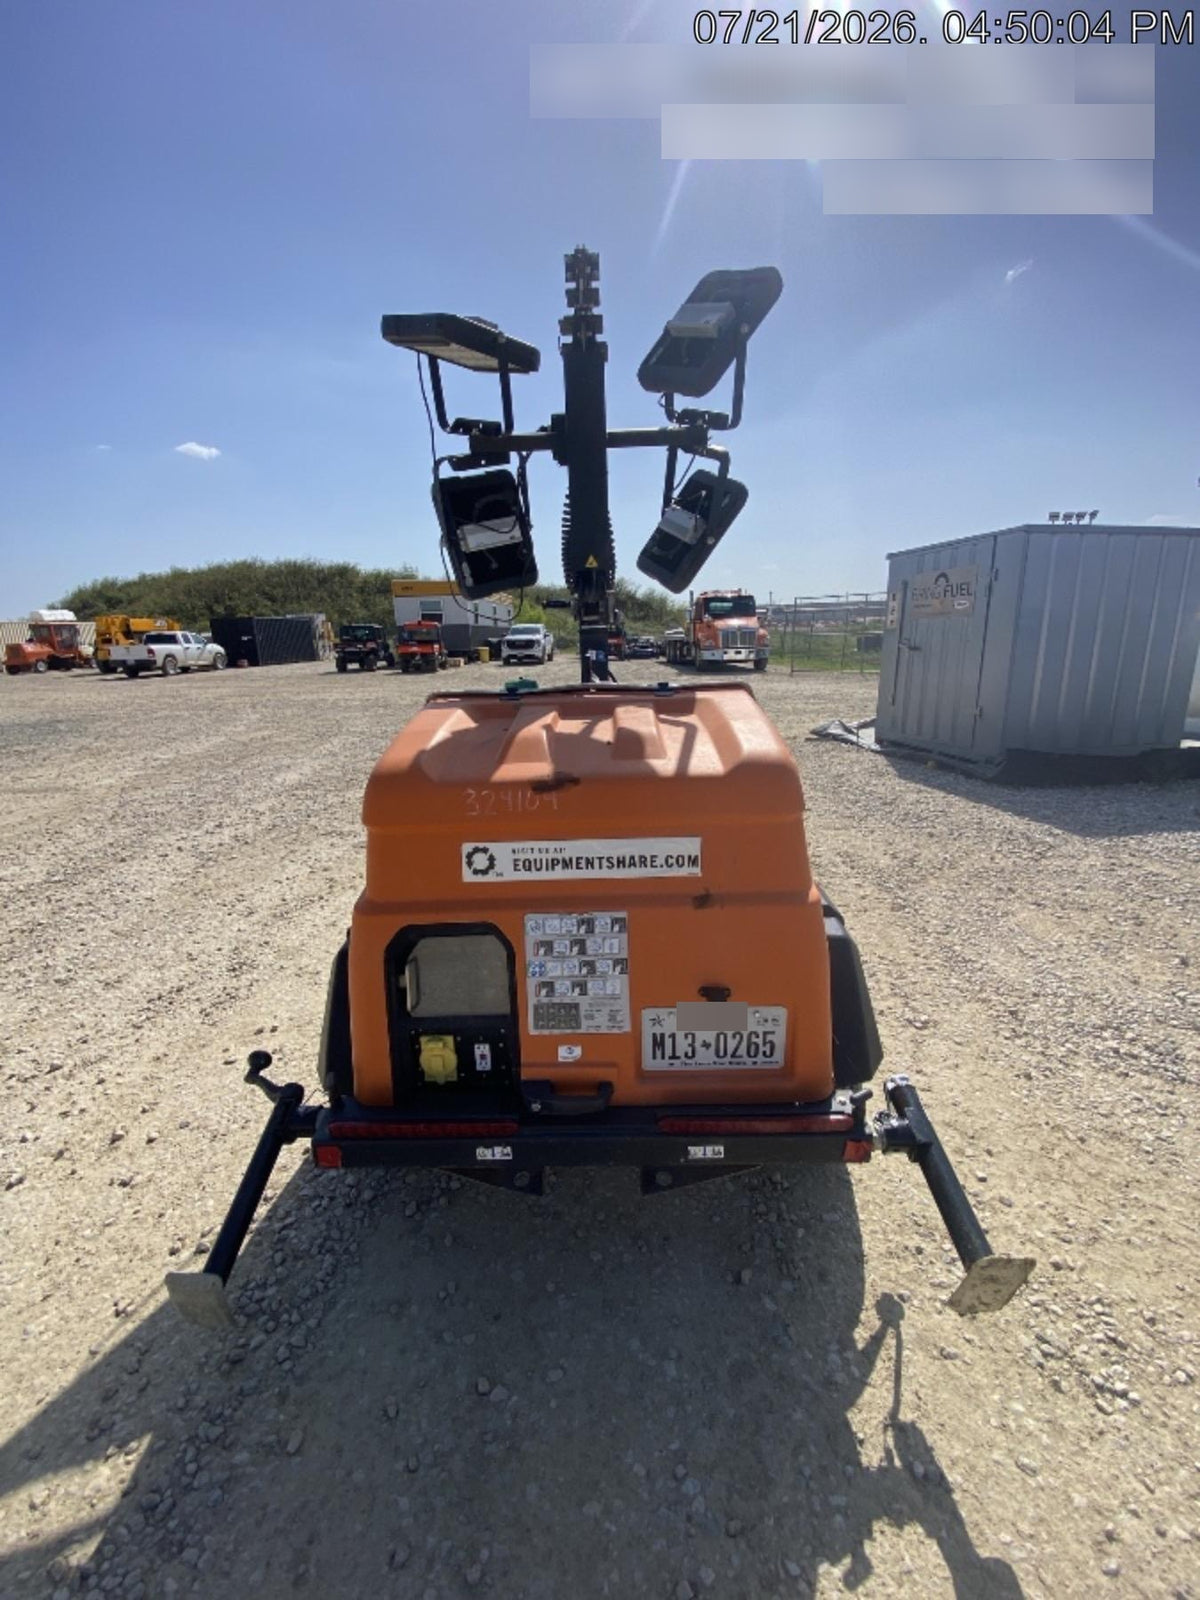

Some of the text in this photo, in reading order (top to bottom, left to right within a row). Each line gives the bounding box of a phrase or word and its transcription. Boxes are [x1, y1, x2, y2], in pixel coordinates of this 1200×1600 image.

[943, 583, 973, 598] FUEL
[513, 854, 700, 872] EQUIPMENTSHARE.COM
[651, 1031, 776, 1060] M13 0265
